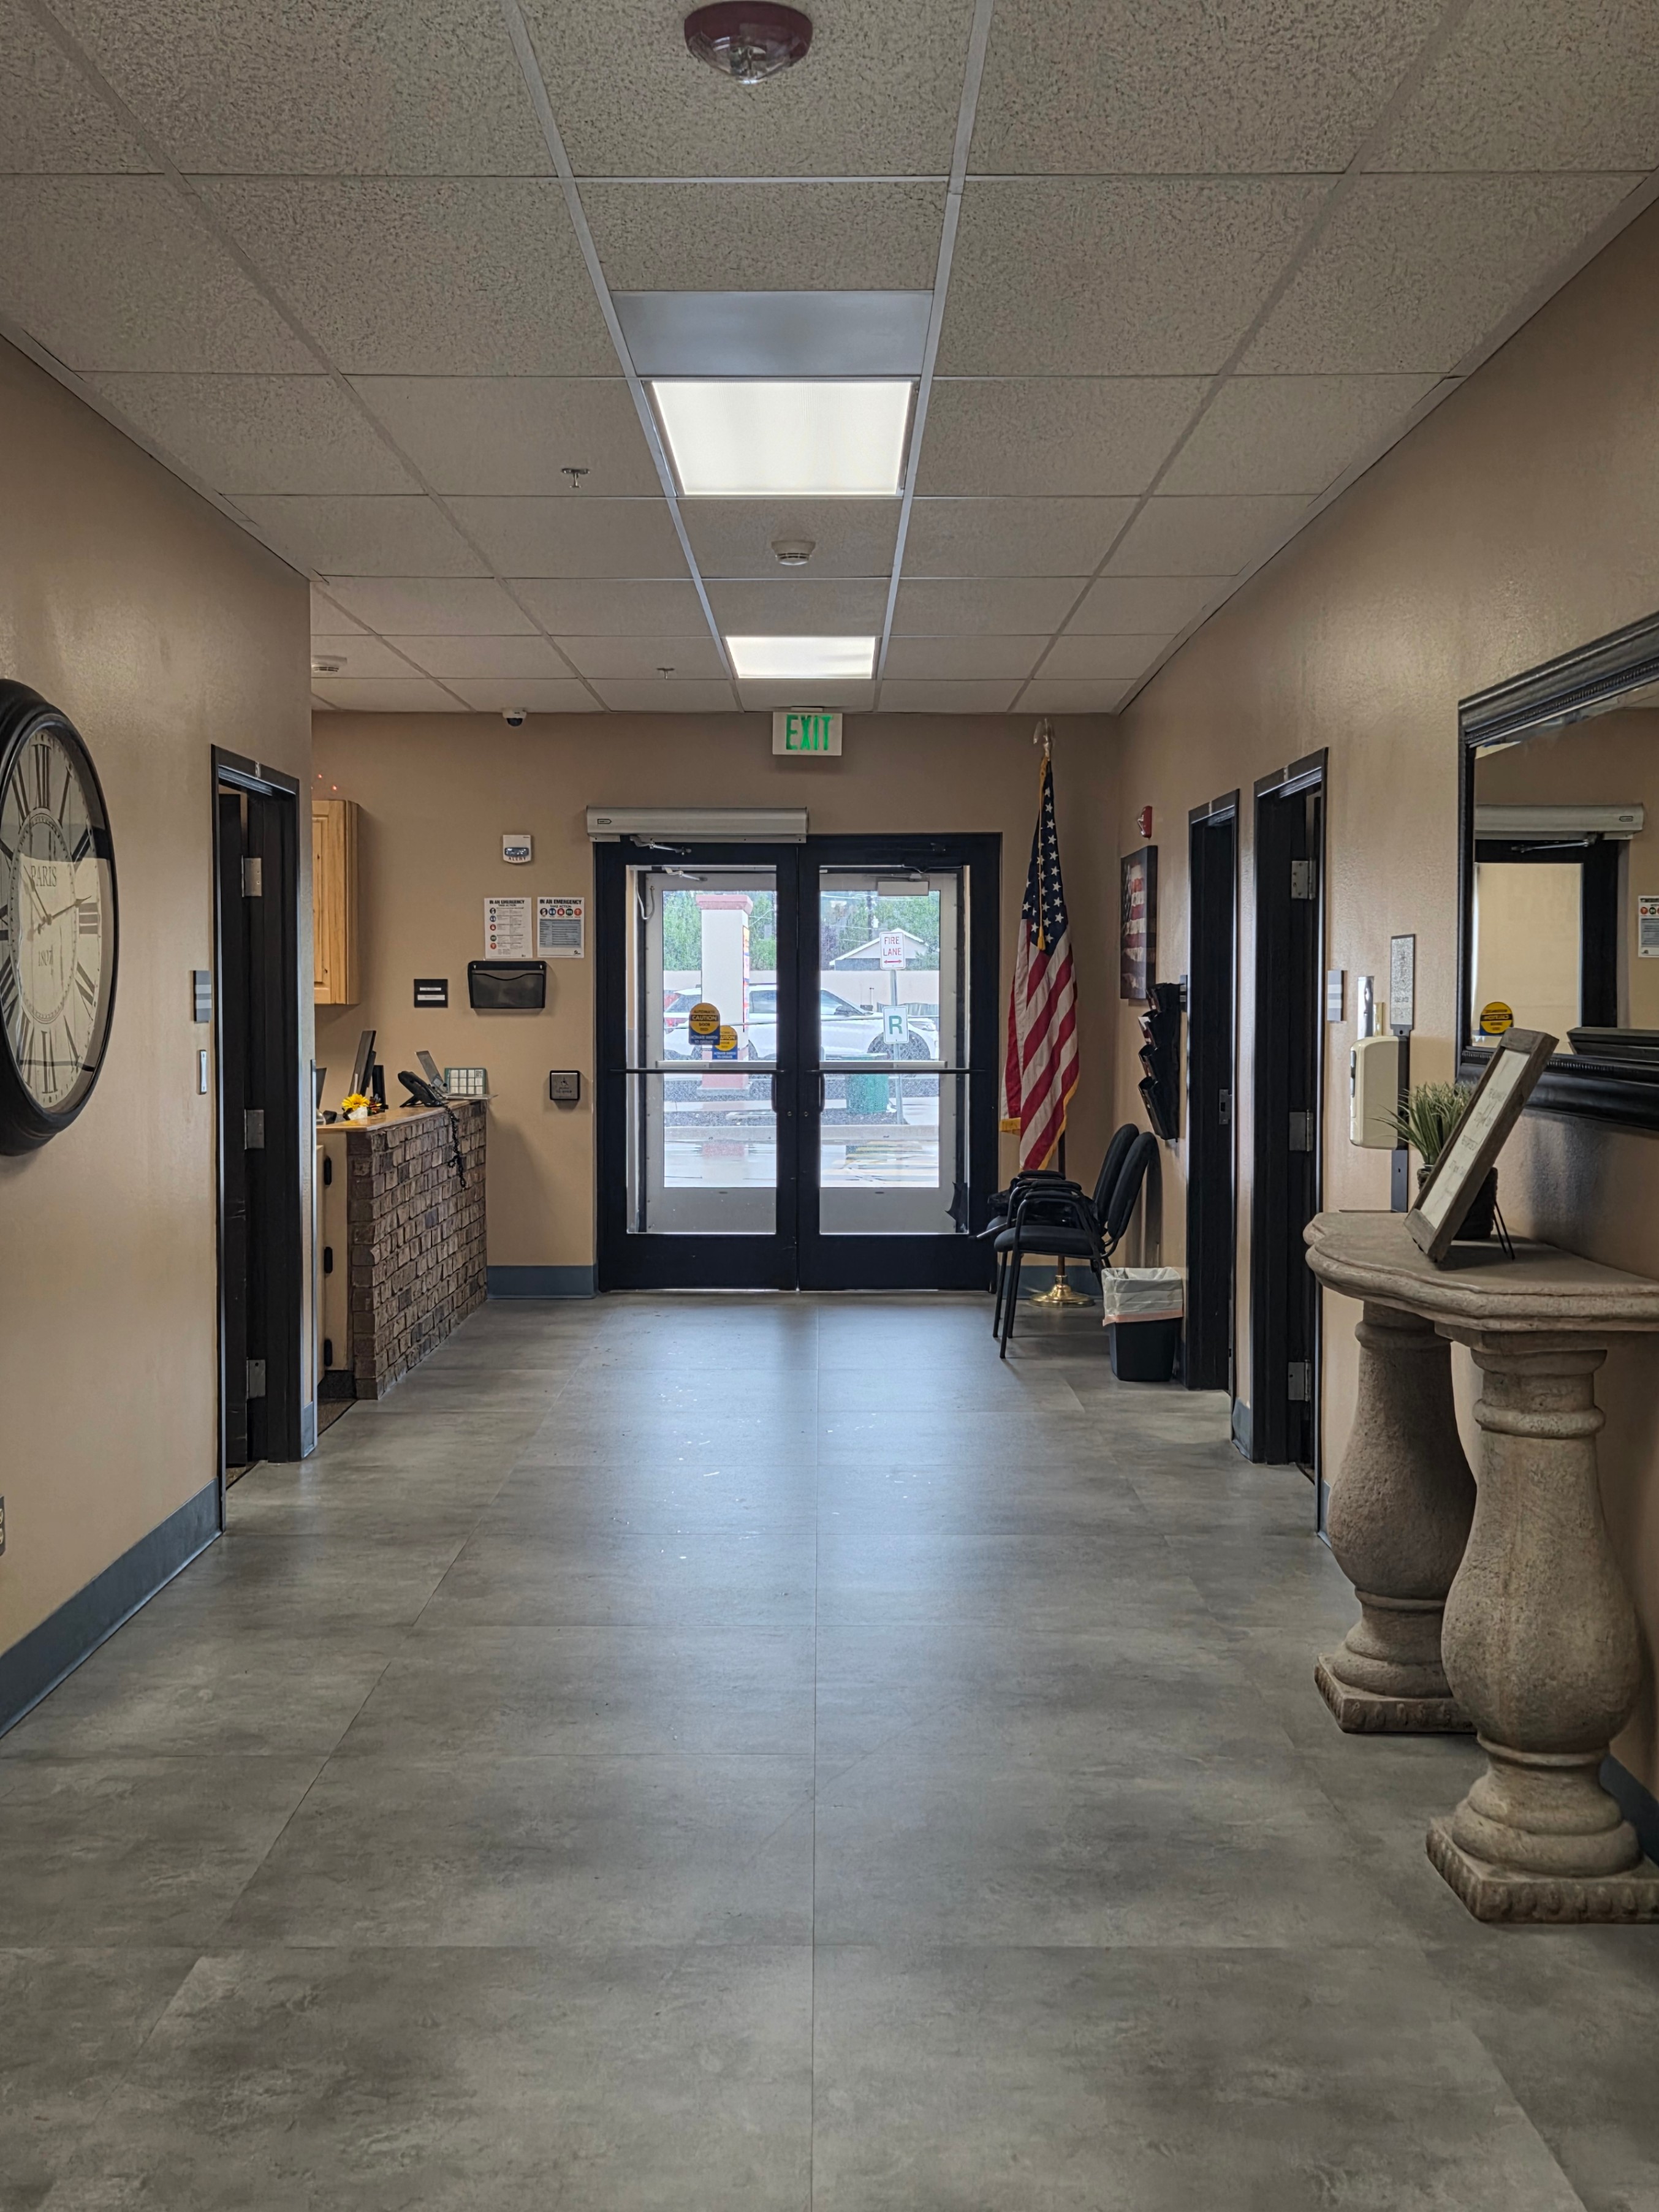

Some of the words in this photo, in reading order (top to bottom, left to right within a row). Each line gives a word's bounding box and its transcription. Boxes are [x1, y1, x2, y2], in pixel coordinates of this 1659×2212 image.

[786, 714, 833, 751] EXIT
[31, 865, 57, 887] PARIS
[889, 1015, 903, 1034] R
